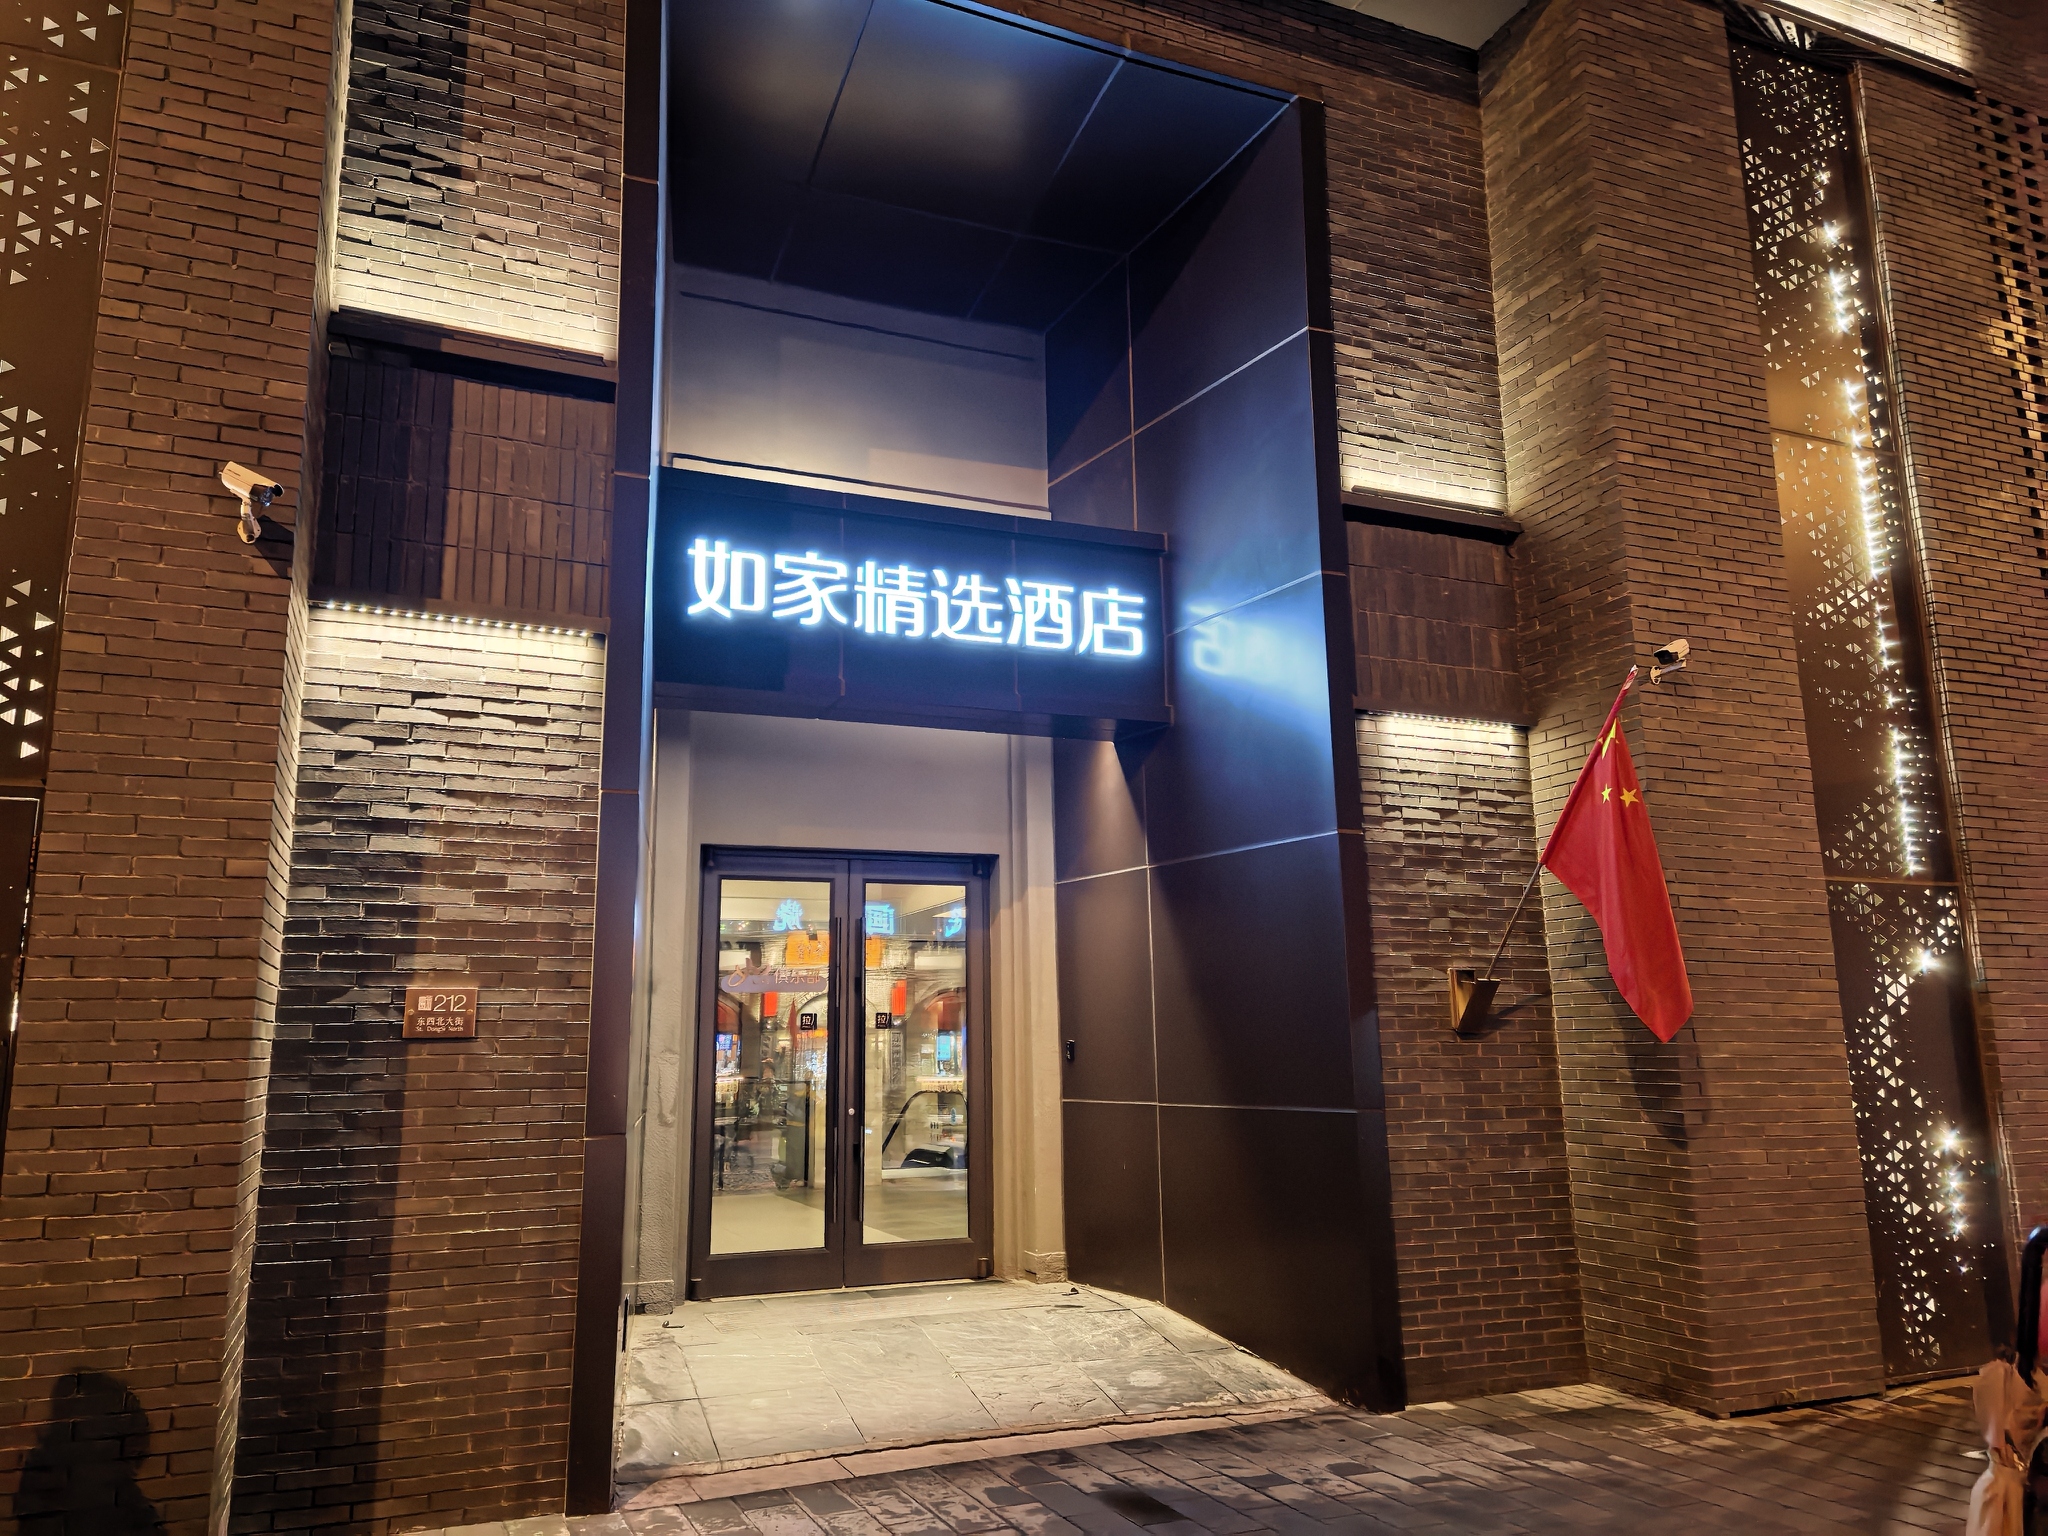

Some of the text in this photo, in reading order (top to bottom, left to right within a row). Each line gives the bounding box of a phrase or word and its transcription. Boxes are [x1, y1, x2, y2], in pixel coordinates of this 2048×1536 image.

[687, 537, 1145, 657] 如家精选酒店
[433, 994, 467, 1012] 212
